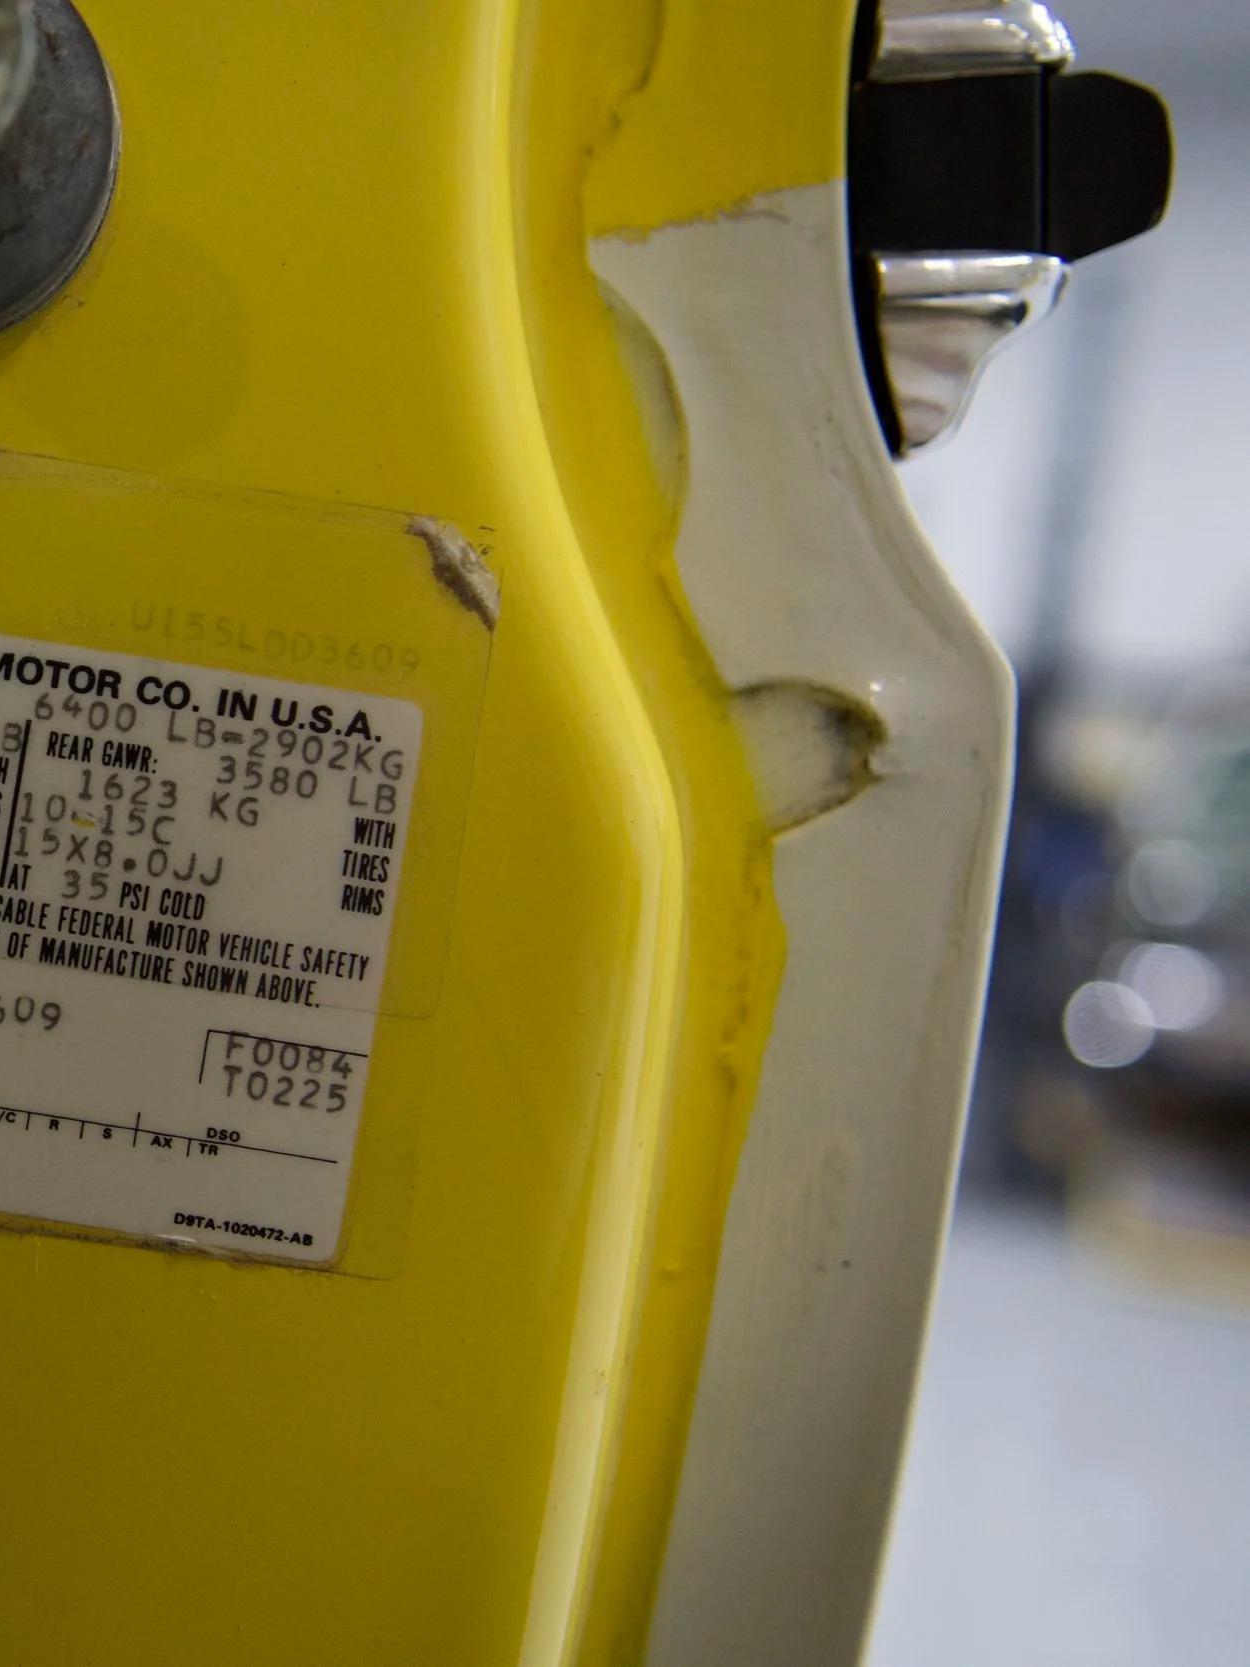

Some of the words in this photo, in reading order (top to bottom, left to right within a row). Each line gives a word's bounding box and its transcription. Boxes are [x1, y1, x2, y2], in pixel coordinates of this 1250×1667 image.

[34, 692, 137, 733] 6400
[136, 676, 199, 713] CO.
[216, 688, 257, 721] IN
[271, 698, 382, 743] U.S.A.
[46, 731, 94, 762] REAR
[102, 739, 158, 773] GAWR:
[216, 755, 318, 799] 3580
[348, 776, 397, 815] LB
[78, 769, 178, 809] 1623
[209, 791, 259, 828] KG
[353, 817, 396, 850] WITH
[342, 850, 391, 884] TIRES
[7, 863, 32, 892] AT
[62, 869, 109, 900] 35
[119, 881, 149, 912] PSI
[158, 888, 207, 921] COLD
[340, 886, 385, 917] RIMS
[58, 905, 135, 945] FEDERAL
[144, 920, 210, 957] MOTOR
[218, 933, 293, 970] VEHICLE
[300, 946, 370, 982] SAFETY
[7, 931, 32, 960] OF
[39, 937, 175, 984] MANUFACTURE
[181, 961, 249, 995] SHOWN
[255, 973, 320, 1009] ABOVE.
[224, 1031, 353, 1080] F0084
[222, 1065, 349, 1114] T0225
[49, 1119, 60, 1131] R
[102, 1127, 113, 1140] S
[150, 1135, 173, 1150] AX
[206, 1127, 241, 1143] DSO
[198, 1143, 220, 1157] TR
